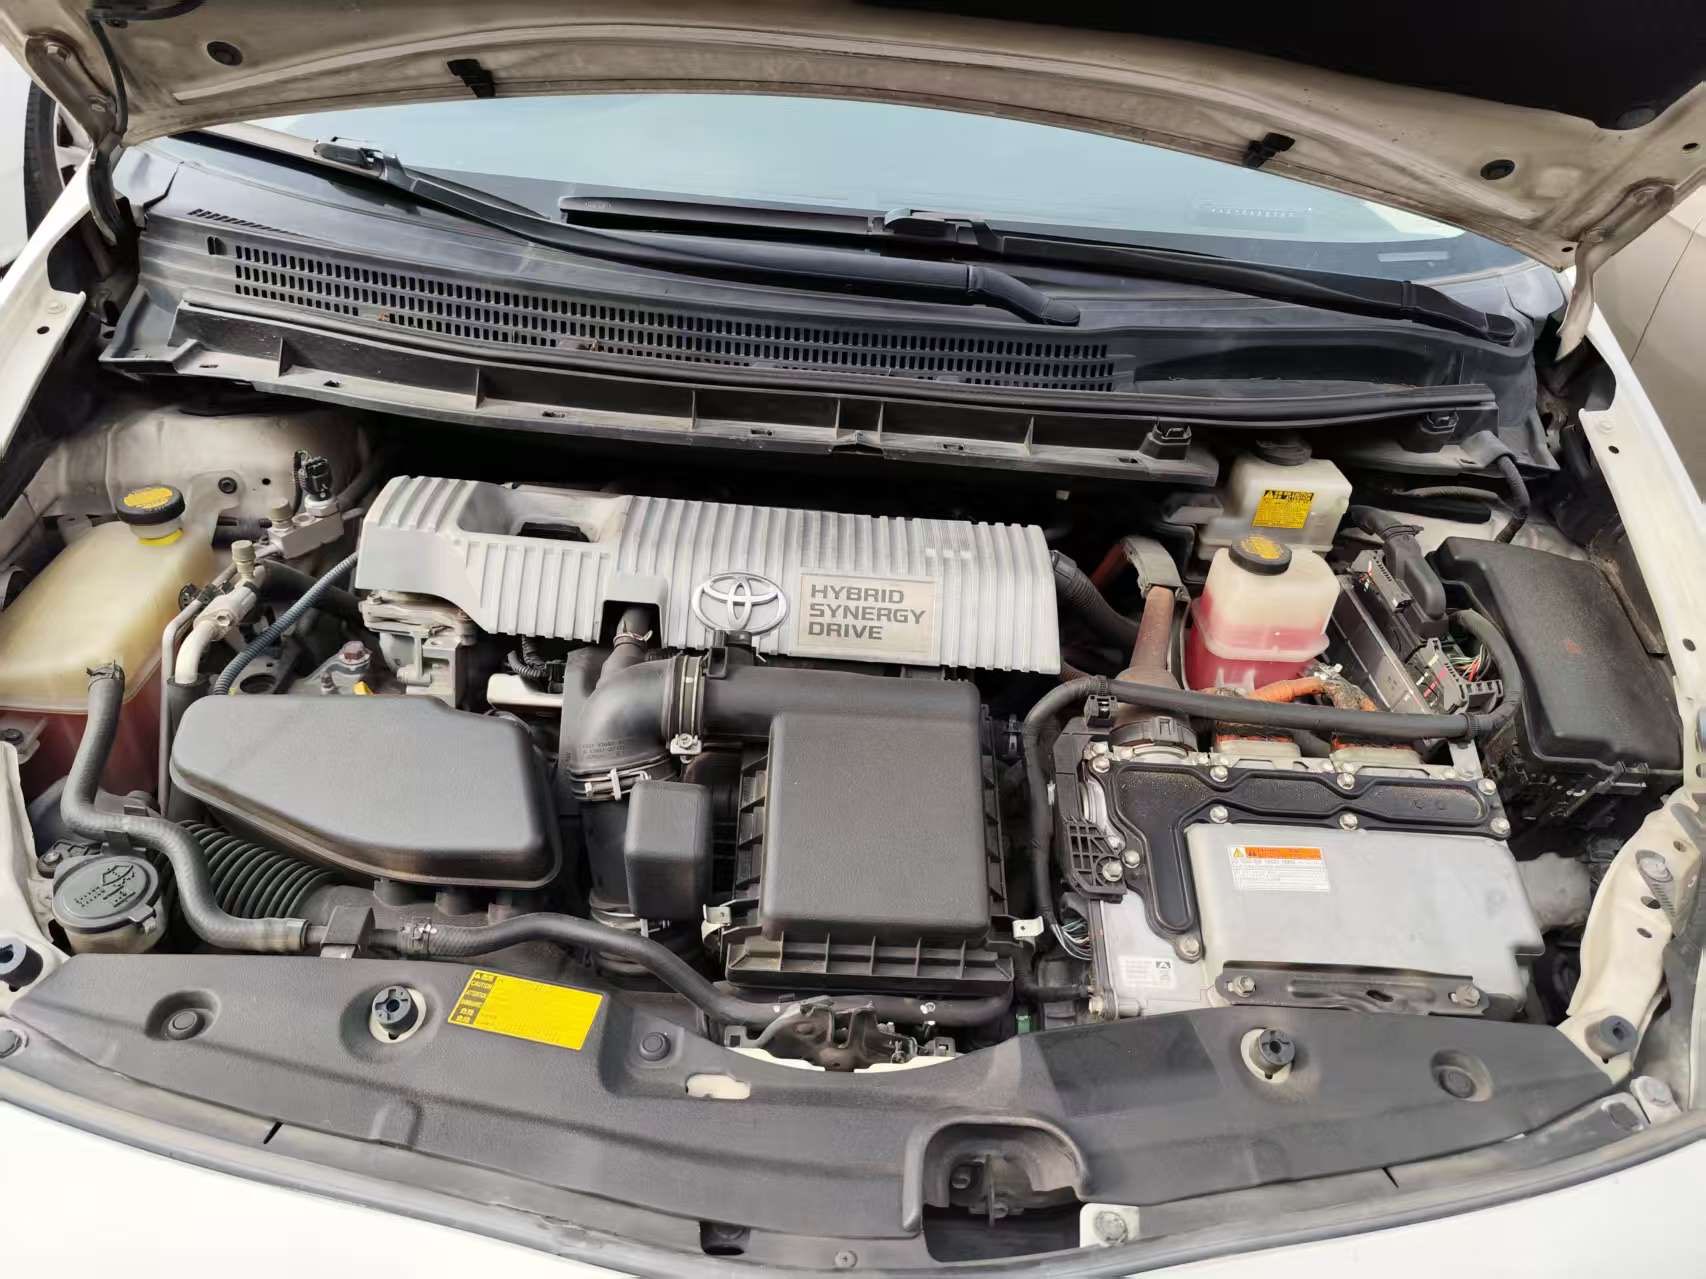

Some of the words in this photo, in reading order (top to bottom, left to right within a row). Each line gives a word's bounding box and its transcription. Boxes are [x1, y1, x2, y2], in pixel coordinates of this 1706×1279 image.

[810, 584, 904, 604] HYBRID
[808, 603, 926, 624] SYNERGY
[807, 621, 883, 640] DRIVE
